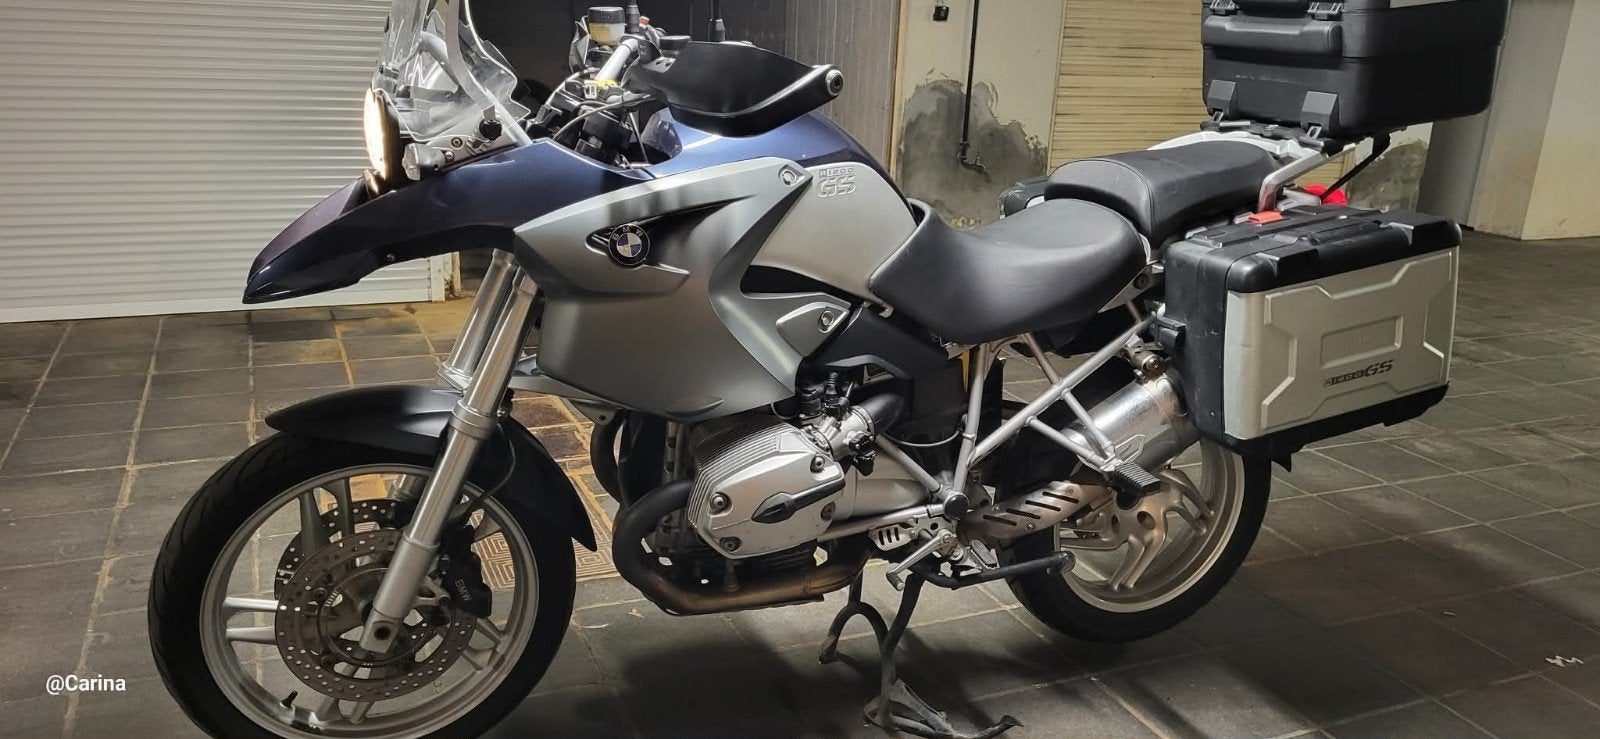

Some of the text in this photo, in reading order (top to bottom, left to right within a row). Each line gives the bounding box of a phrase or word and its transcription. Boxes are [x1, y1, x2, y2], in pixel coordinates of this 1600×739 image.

[817, 175, 856, 198] GS
[612, 226, 643, 240] BMW
[455, 579, 471, 600] BMW
